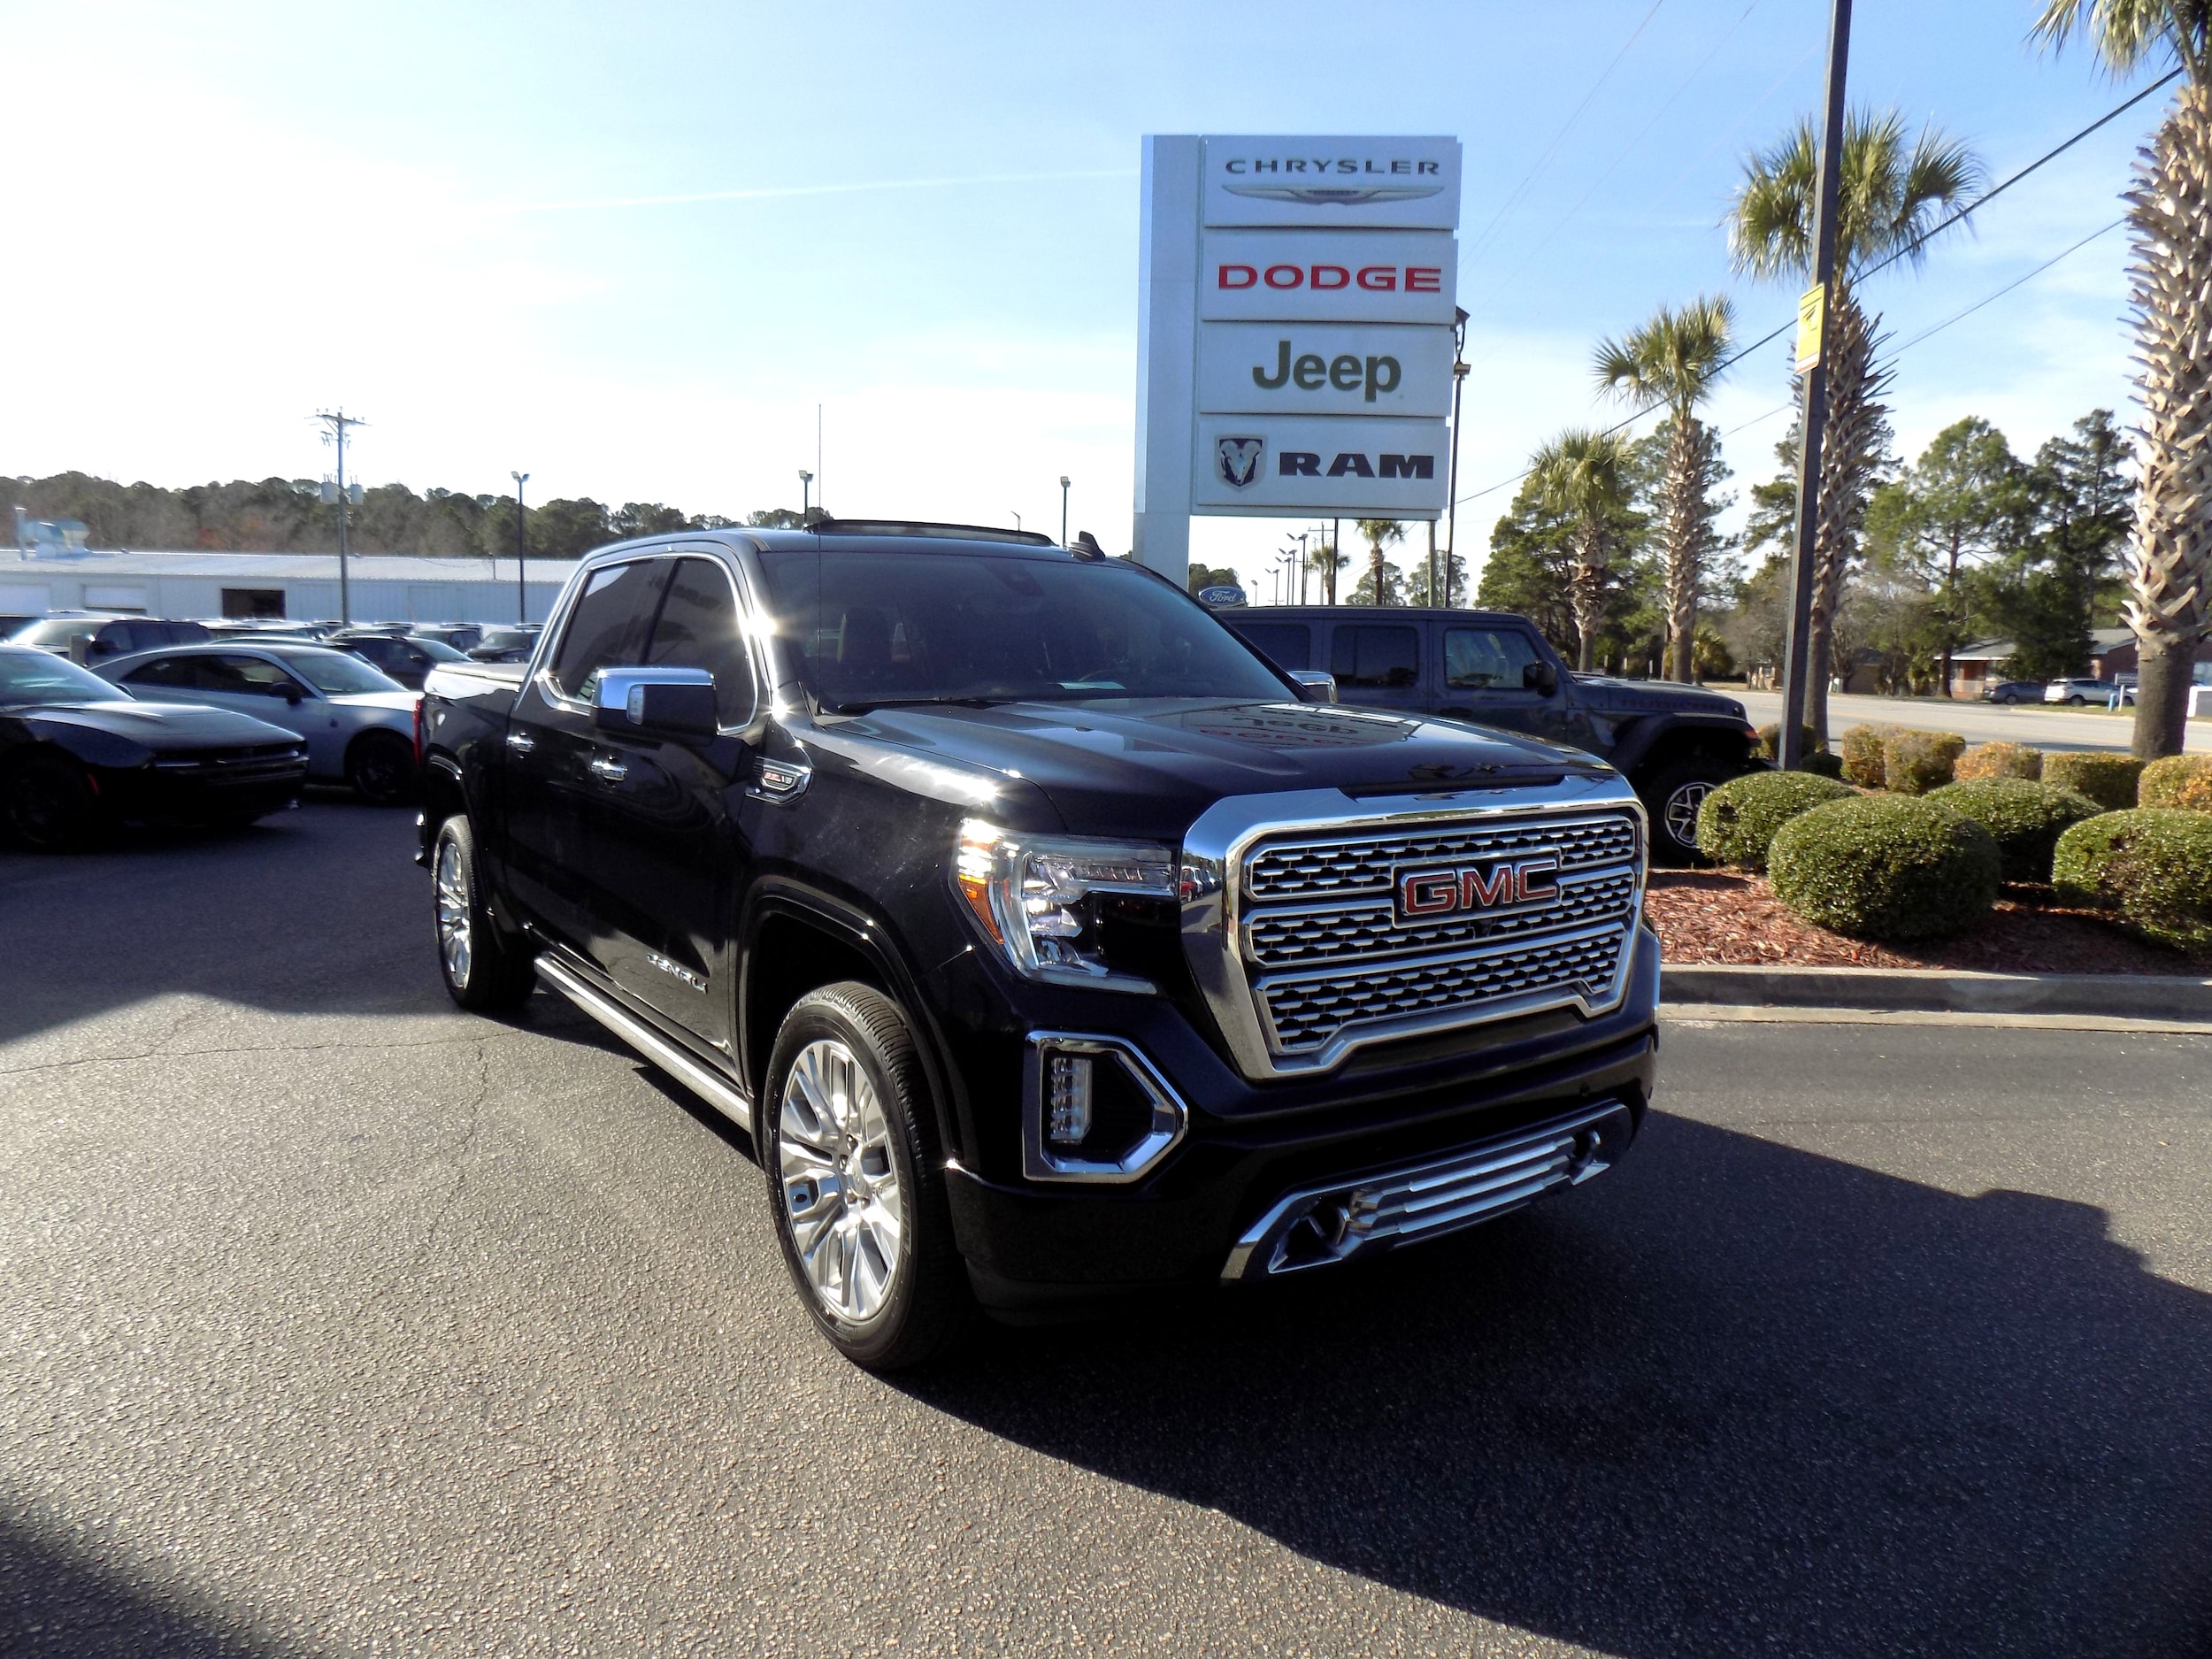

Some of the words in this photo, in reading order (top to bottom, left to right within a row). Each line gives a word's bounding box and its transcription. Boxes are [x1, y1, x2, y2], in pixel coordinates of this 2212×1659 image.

[1225, 157, 1440, 176] CHRYSLER
[1217, 265, 1442, 293] DODGE
[1252, 340, 1402, 403] Jeep
[1279, 451, 1435, 479] RAM
[1209, 590, 1238, 603] Ford
[1401, 858, 1558, 917] GMC
